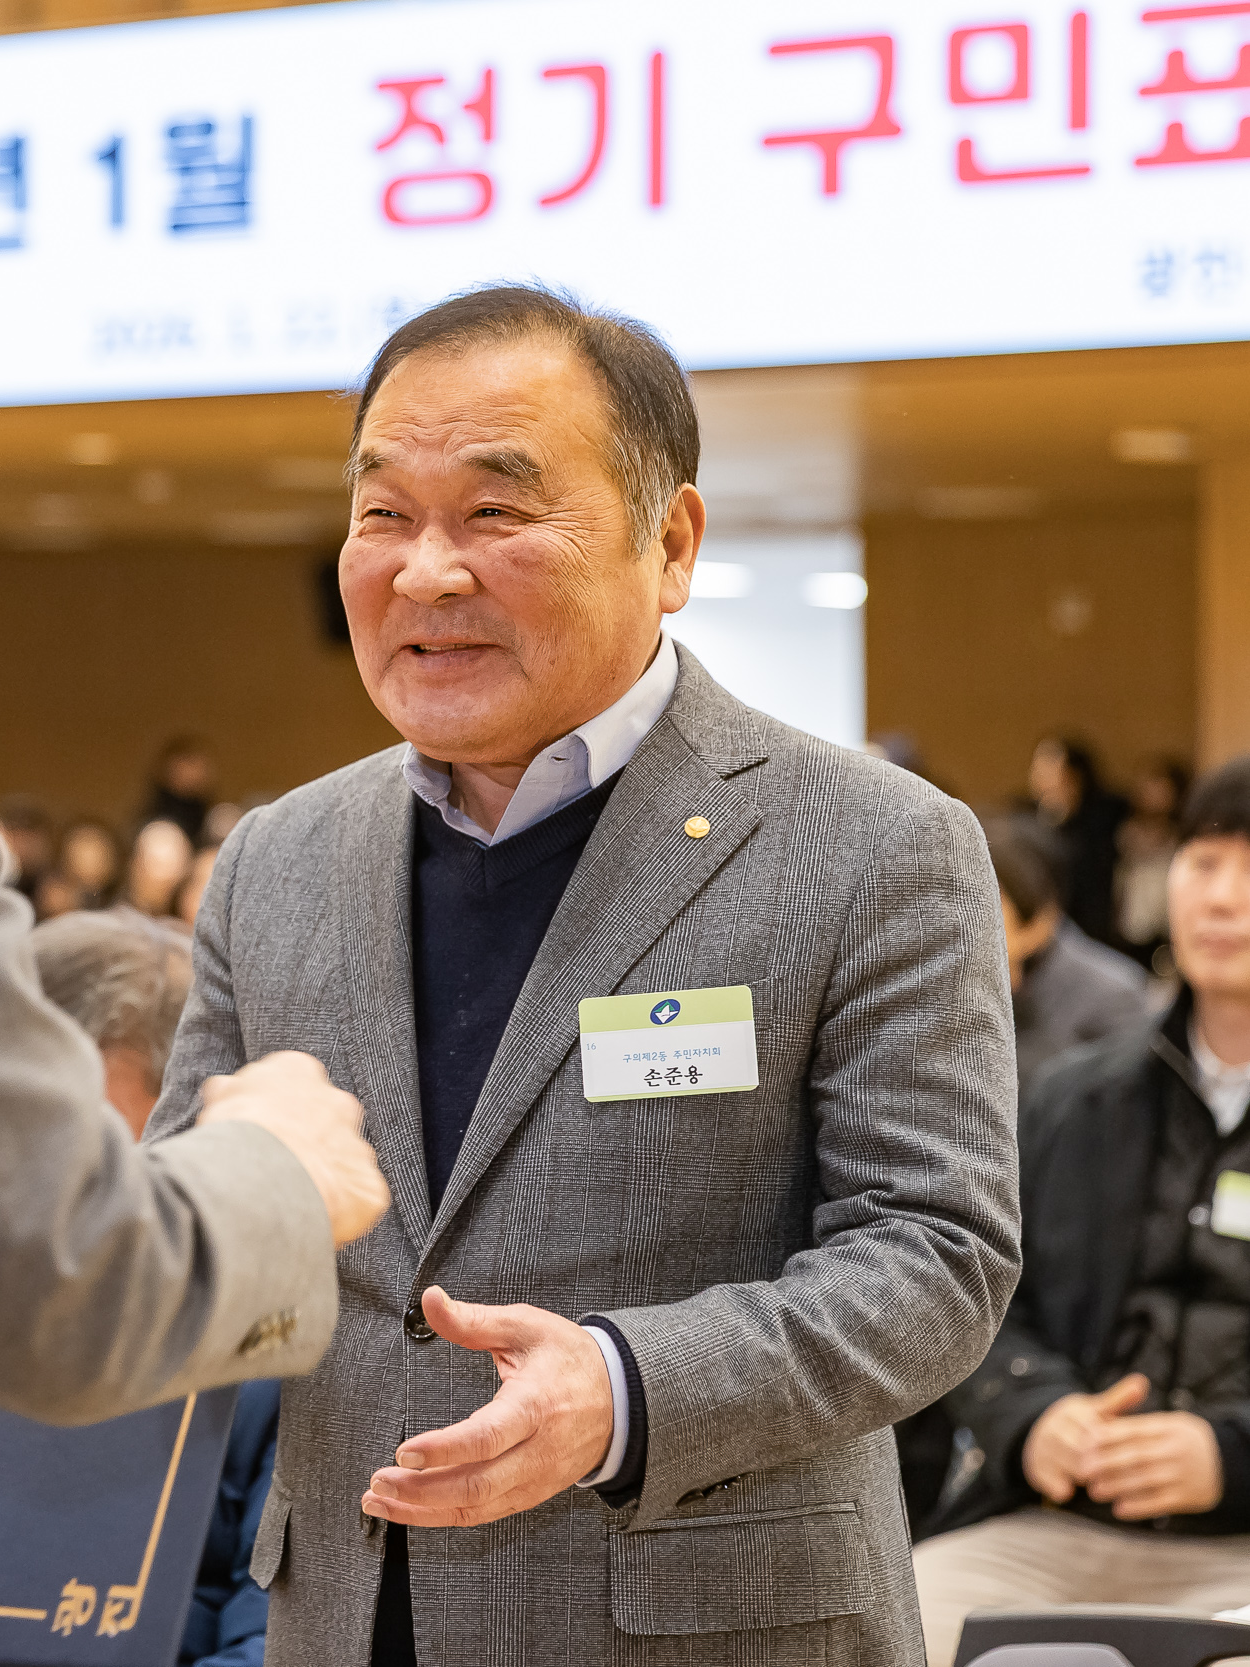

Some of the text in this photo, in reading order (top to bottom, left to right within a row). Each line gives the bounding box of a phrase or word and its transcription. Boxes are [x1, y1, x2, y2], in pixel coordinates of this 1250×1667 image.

[374, 50, 666, 227] 정기
[586, 1043, 597, 1051] 16
[622, 1047, 721, 1063] 구의제2동 주민자치회
[643, 1064, 703, 1087] 손준용
